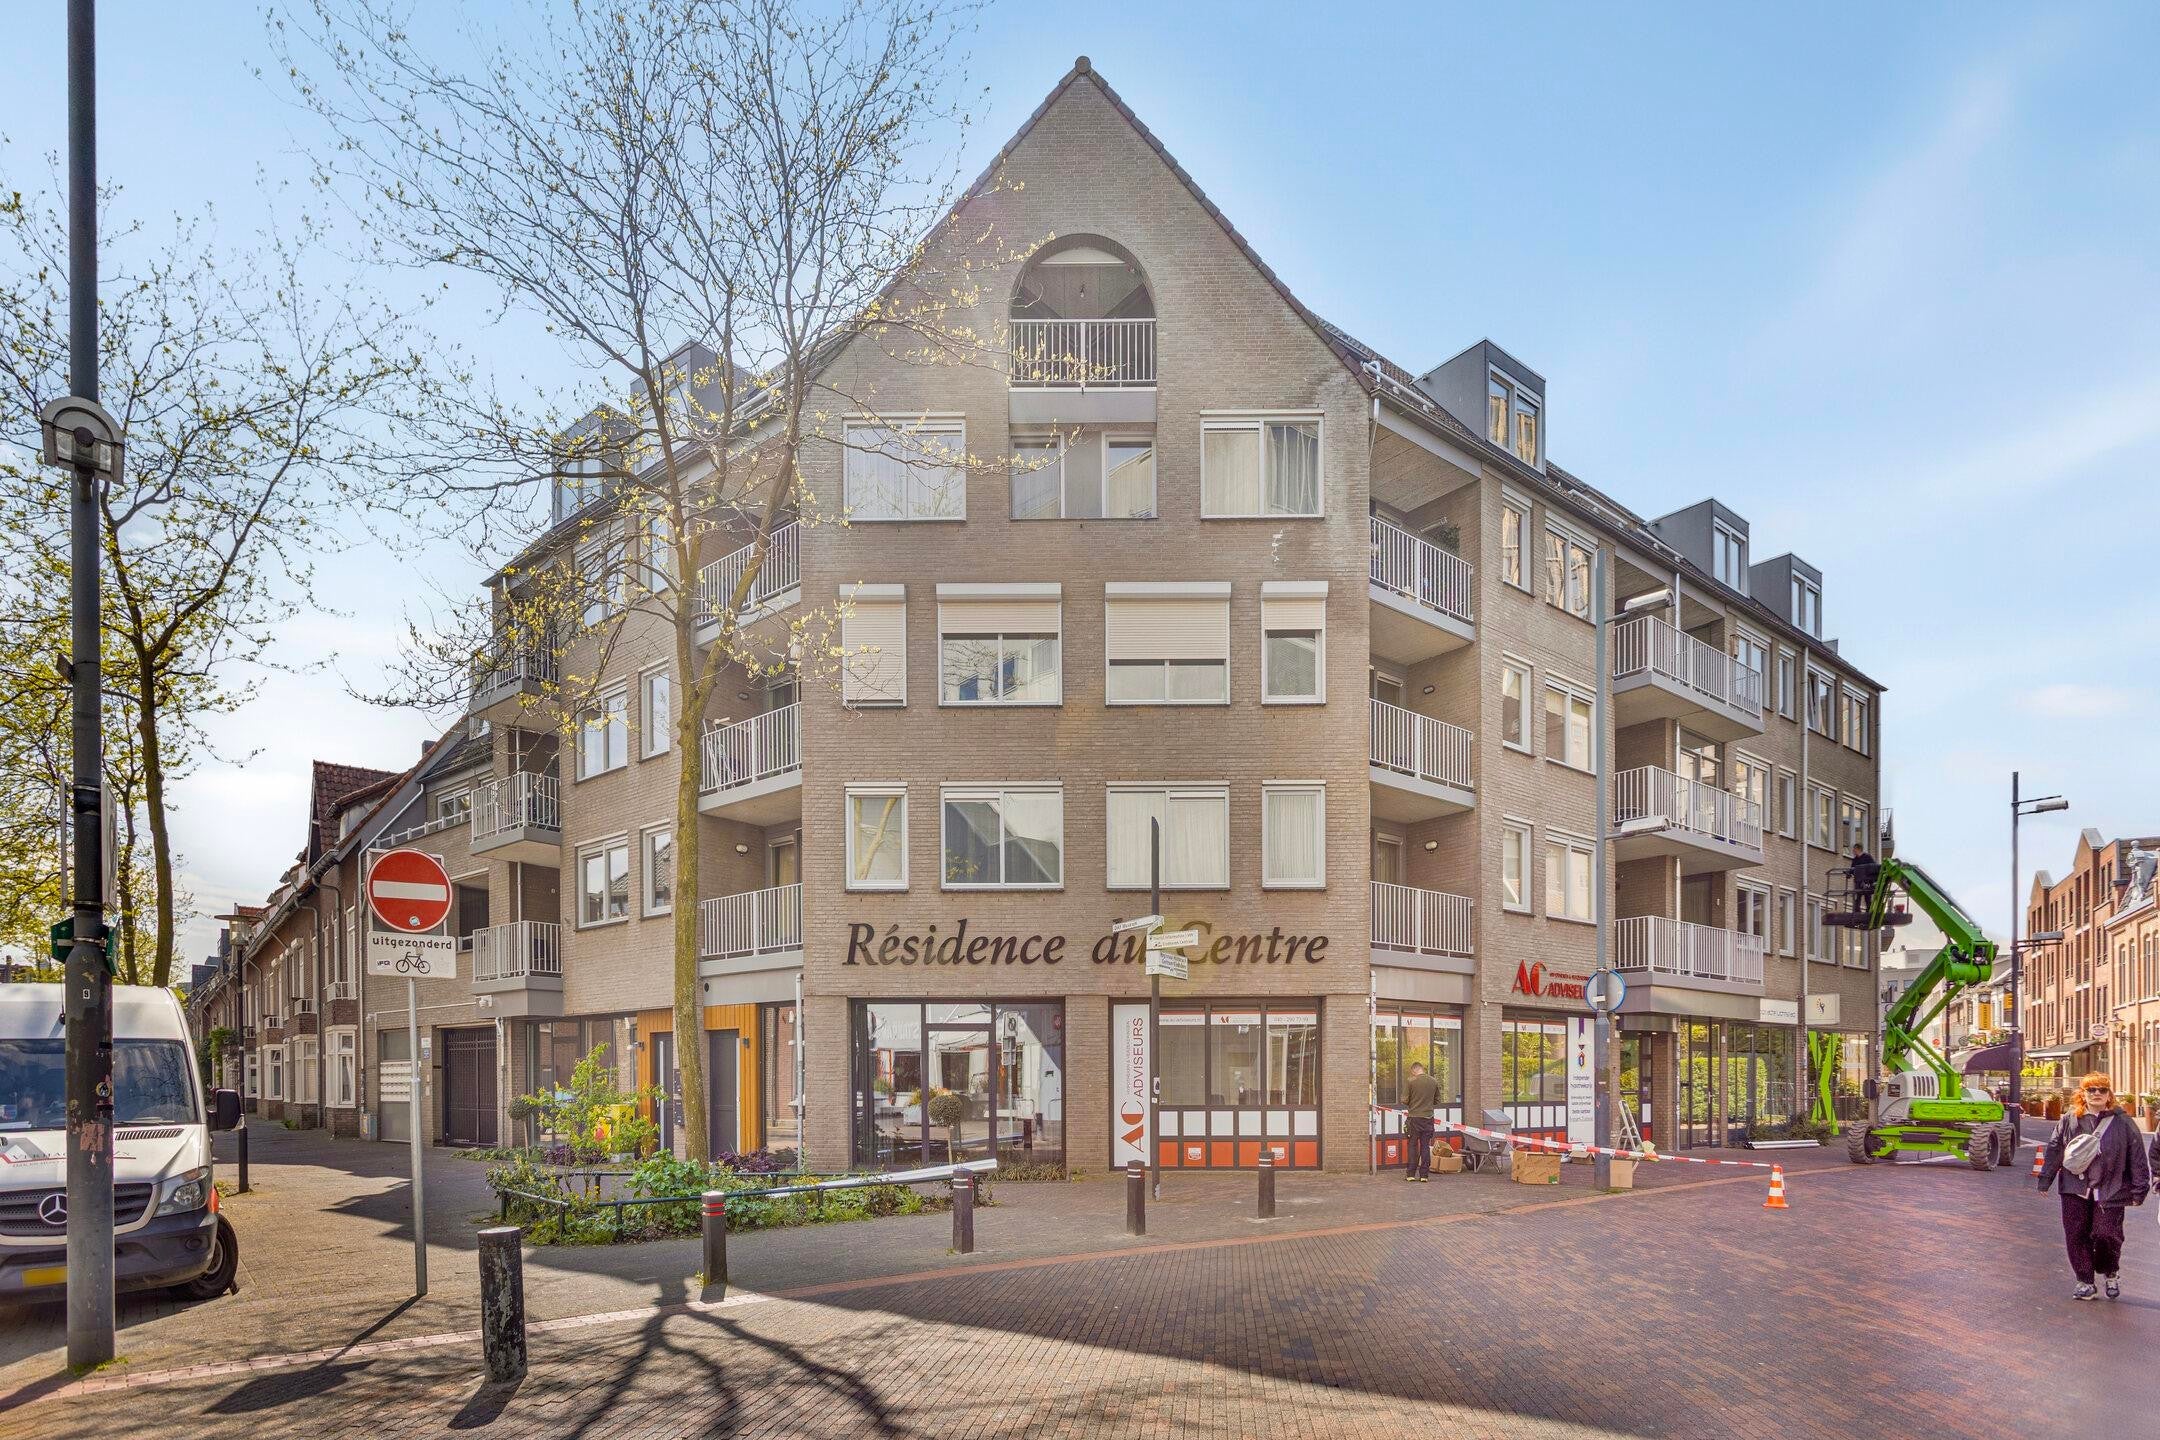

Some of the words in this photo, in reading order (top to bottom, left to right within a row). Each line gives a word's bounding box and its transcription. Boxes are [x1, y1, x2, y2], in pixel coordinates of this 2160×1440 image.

[372, 937, 452, 949] uitgezonderd
[842, 918, 1066, 966] Résidence
[1092, 917, 1147, 965] du
[1177, 920, 1329, 965] Centre
[1511, 959, 1547, 996] AC
[1133, 1017, 1144, 1098] ADVISEURS
[1120, 1101, 1145, 1153] AC
